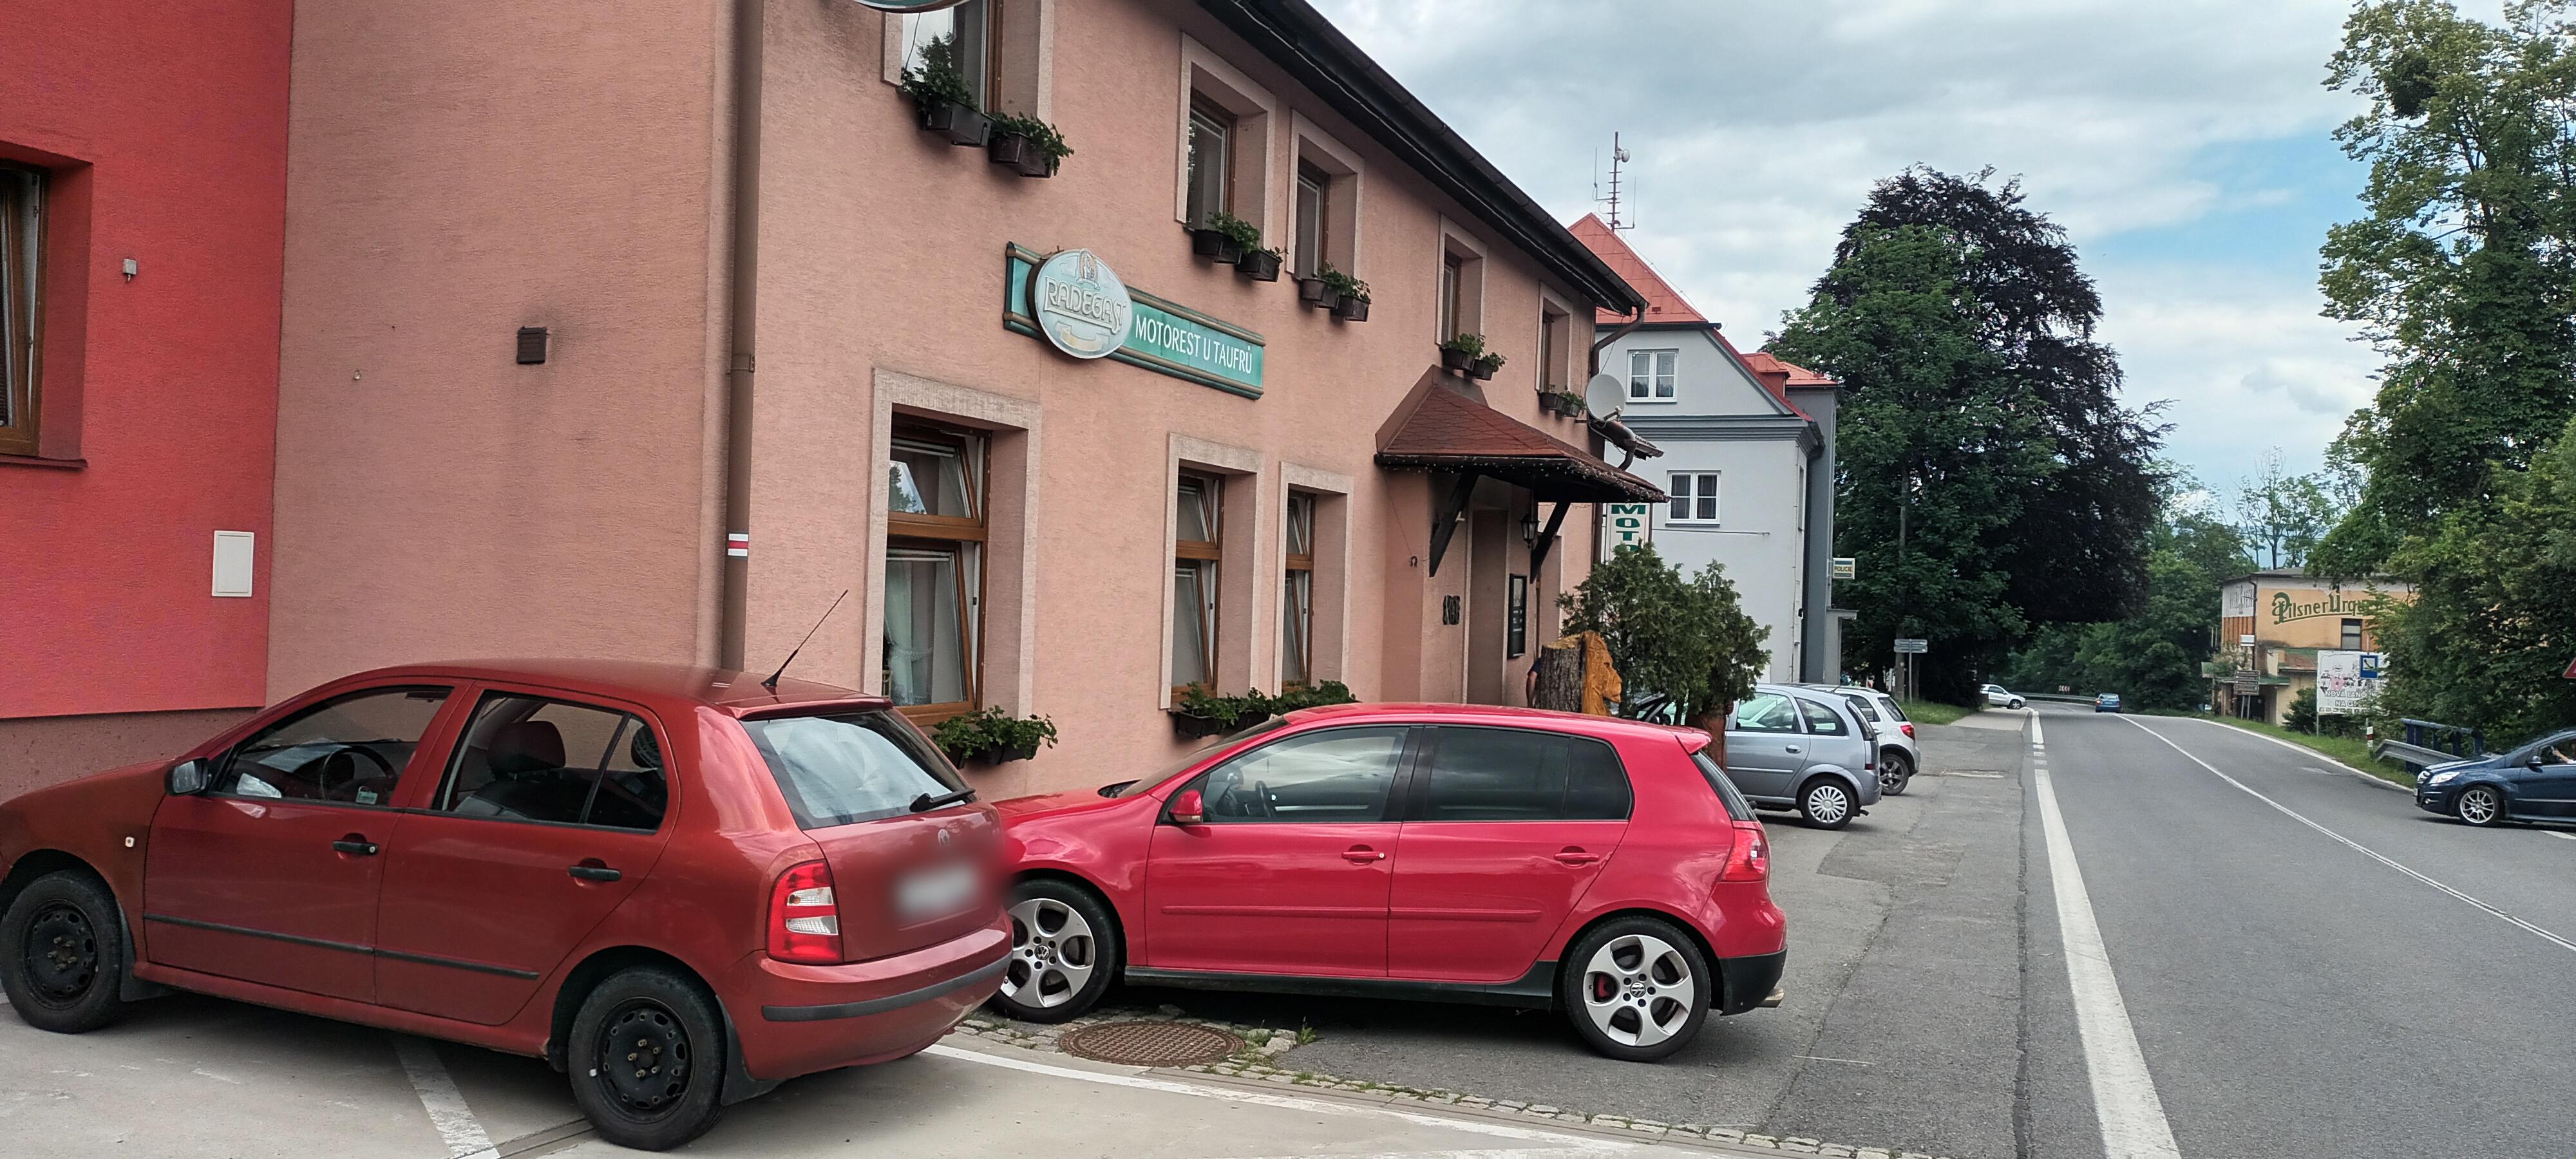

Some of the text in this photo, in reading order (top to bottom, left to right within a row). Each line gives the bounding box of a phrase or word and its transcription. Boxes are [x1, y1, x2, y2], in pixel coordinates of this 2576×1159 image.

[1044, 277, 1126, 334] RADEGAST
[1135, 314, 1253, 374] MOTOREST U TAUFRŮ
[2271, 592, 2329, 625] Pilsner
